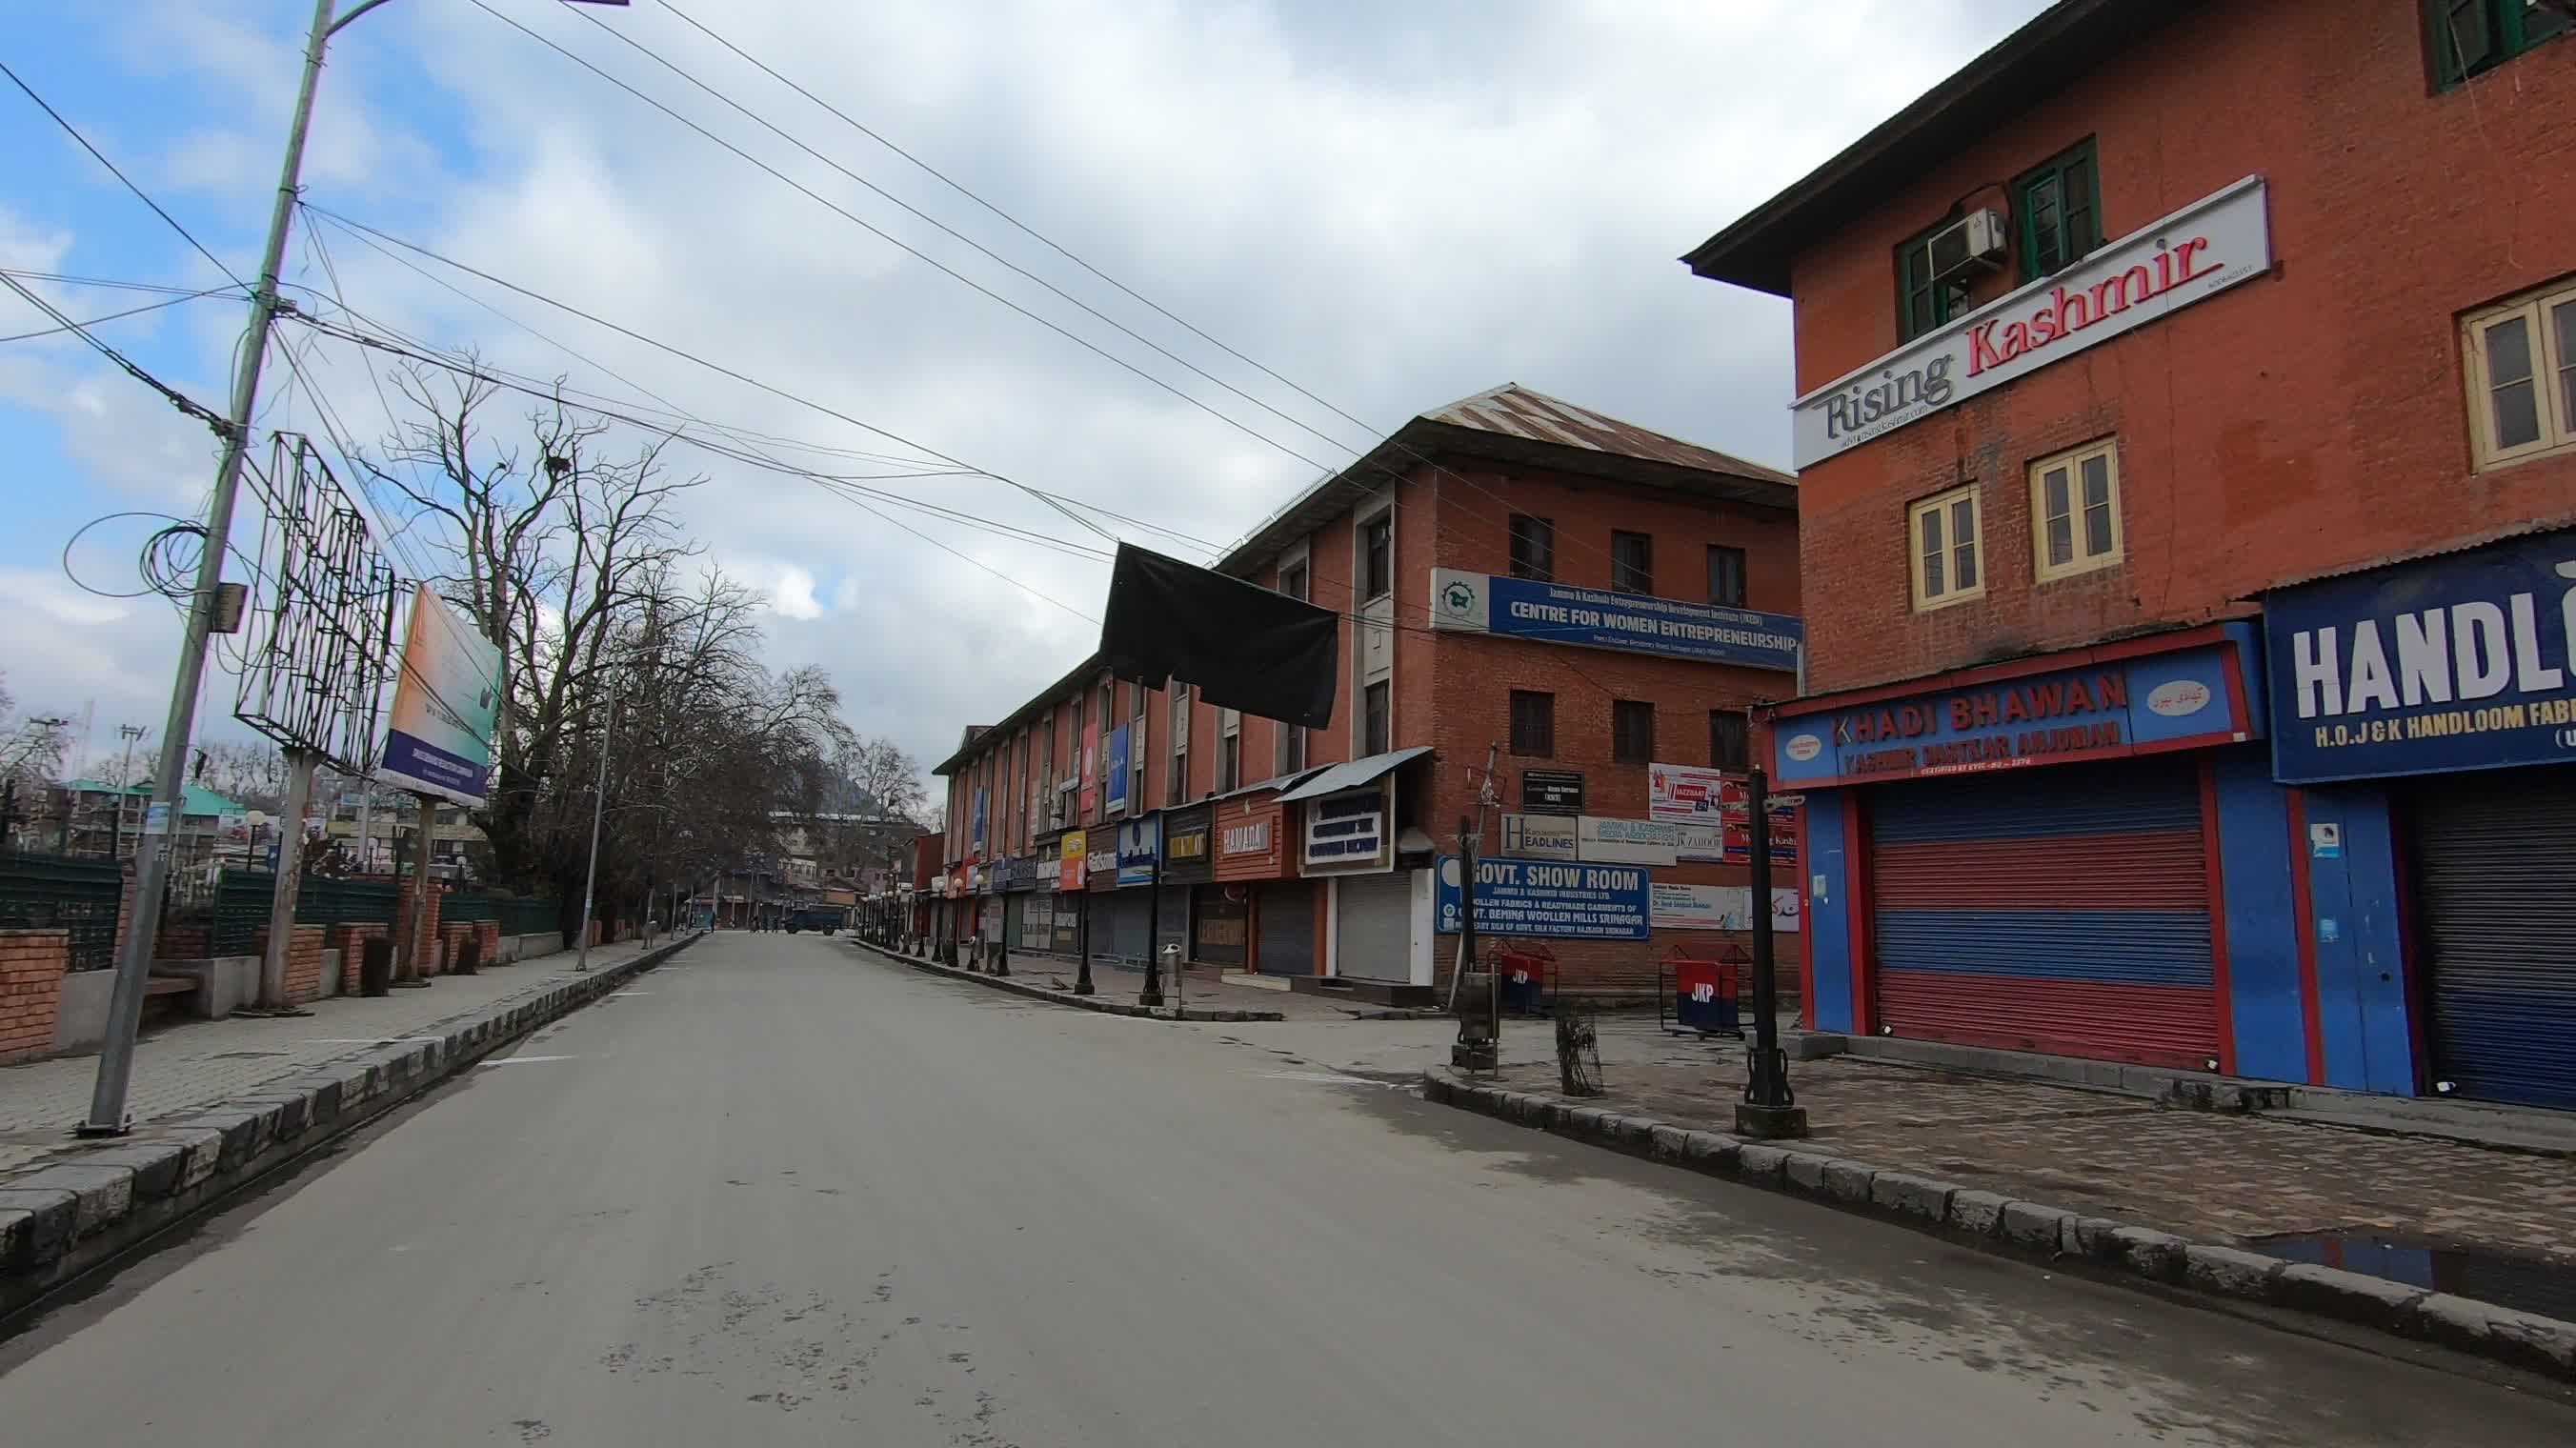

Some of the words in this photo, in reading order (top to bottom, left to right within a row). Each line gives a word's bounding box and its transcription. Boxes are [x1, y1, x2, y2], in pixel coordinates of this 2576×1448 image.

[1813, 353, 1955, 439] Rising
[1966, 235, 2224, 378] Kashmir
[1510, 600, 1568, 623] CENTRE
[1570, 609, 1600, 628] FOR
[1602, 613, 1658, 635] WOMEN
[1660, 619, 1798, 652] ENTREPRENEURSHIP
[1832, 706, 1938, 748] KHADI
[1949, 673, 2127, 731] BHAWAN
[2406, 705, 2526, 739] HANDLOOM
[1526, 865, 1581, 888] SHOW
[1586, 868, 1639, 892] ROOM
[1488, 909, 1524, 921] BEMINA
[1526, 911, 1572, 923] WOOLLEN
[1572, 912, 1598, 924] MILLS
[1599, 914, 1643, 927] SRINAGAR
[1500, 899, 1533, 909] FABRICS
[1586, 902, 1626, 913] GARMENTS
[1626, 904, 1638, 914] OF
[1512, 968, 1528, 984] JKP
[1691, 983, 1713, 1003] JKP
